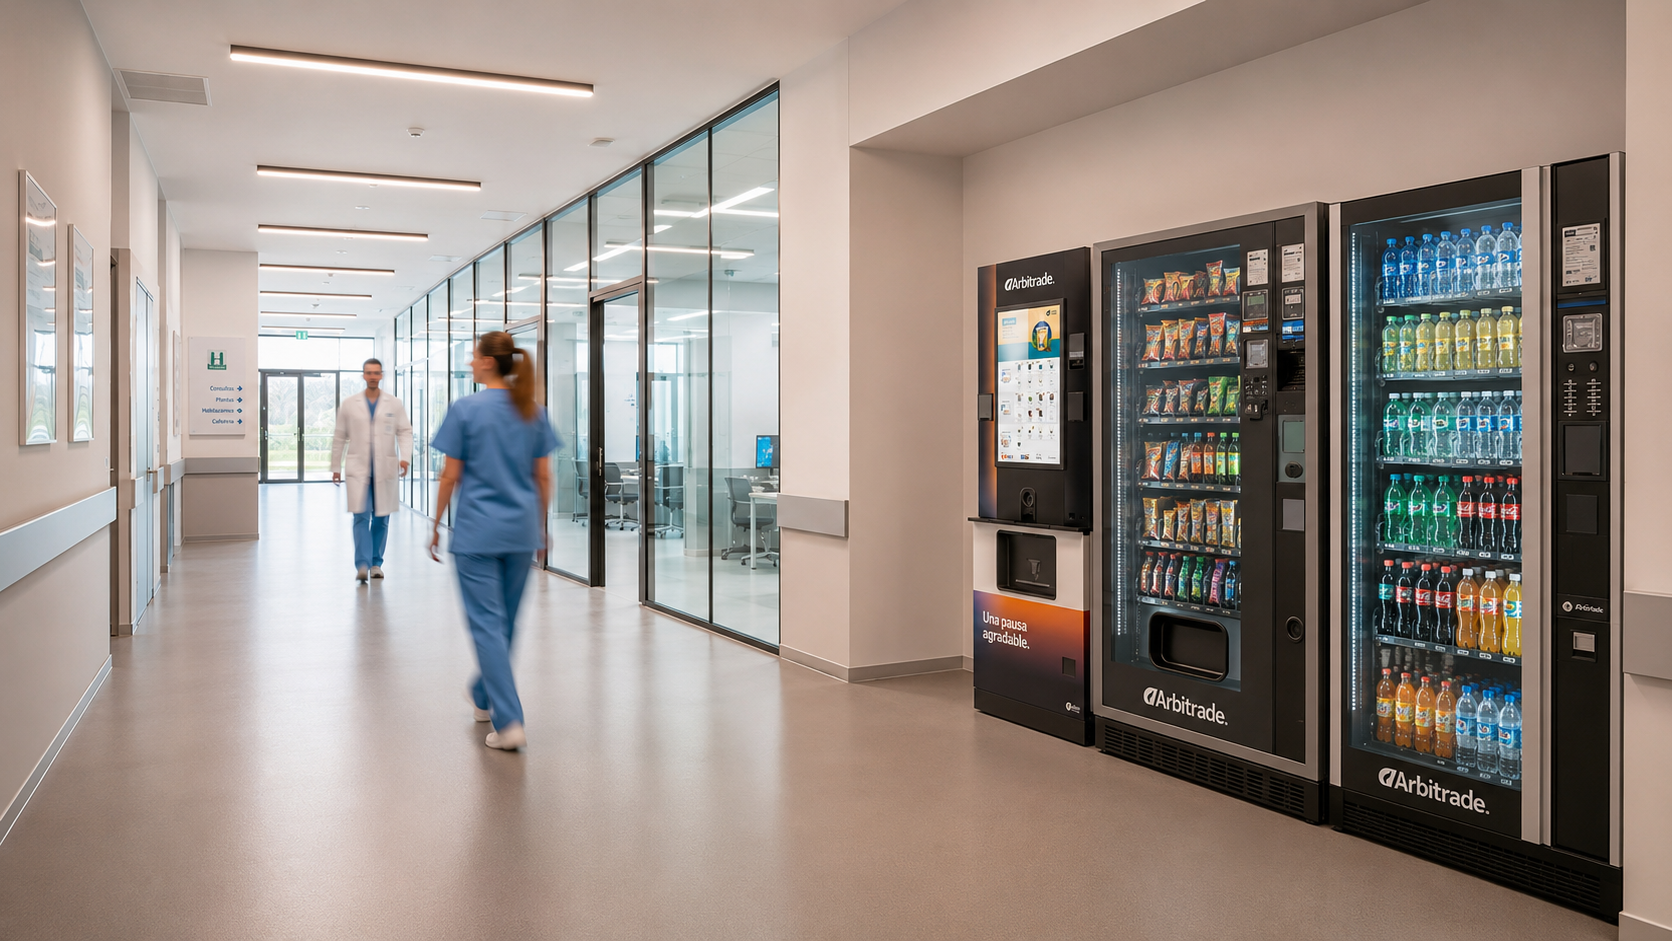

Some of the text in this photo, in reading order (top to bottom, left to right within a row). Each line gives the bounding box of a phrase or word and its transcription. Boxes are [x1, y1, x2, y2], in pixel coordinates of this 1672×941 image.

[1011, 271, 1056, 290] Arbitrade.
[982, 610, 1028, 632] Una pausa
[982, 629, 1030, 650] agradable.
[1155, 689, 1229, 726] Arbitrade.
[1394, 770, 1490, 815] Arbitrade.
